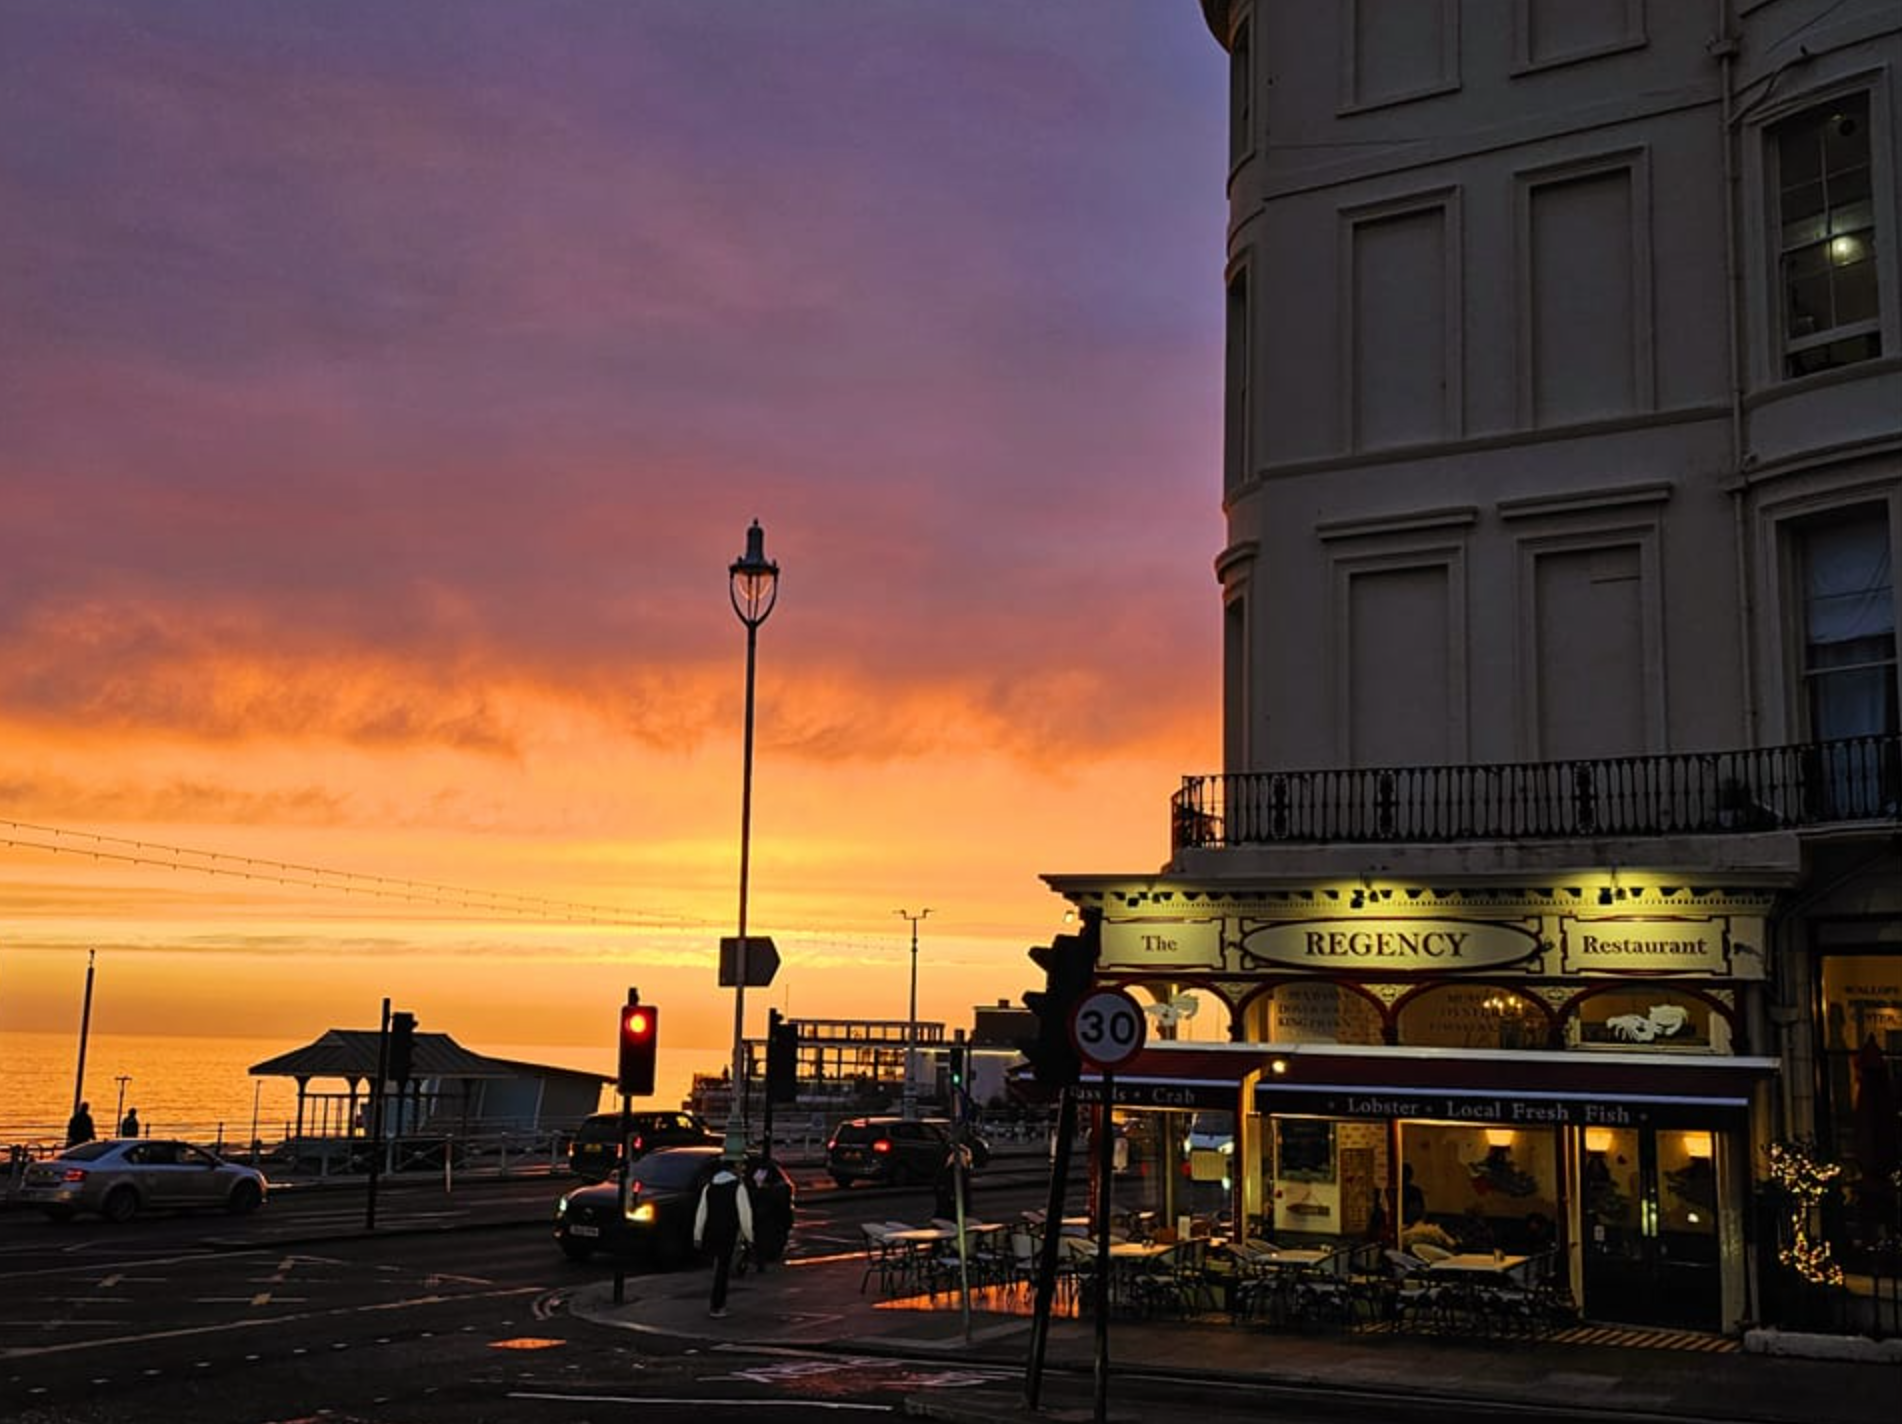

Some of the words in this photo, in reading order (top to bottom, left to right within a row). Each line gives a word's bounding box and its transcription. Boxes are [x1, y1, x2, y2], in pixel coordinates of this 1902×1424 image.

[1141, 935, 1178, 952] The
[1304, 931, 1470, 958] REGENCY
[1582, 935, 1708, 955] Restaurant
[1080, 1009, 1136, 1045] 30
[1152, 1086, 1196, 1105] Crab
[1347, 1096, 1420, 1116] Lobster
[1446, 1099, 1501, 1120] Local
[1512, 1102, 1569, 1122] Fresh
[1584, 1104, 1630, 1125] Fish
